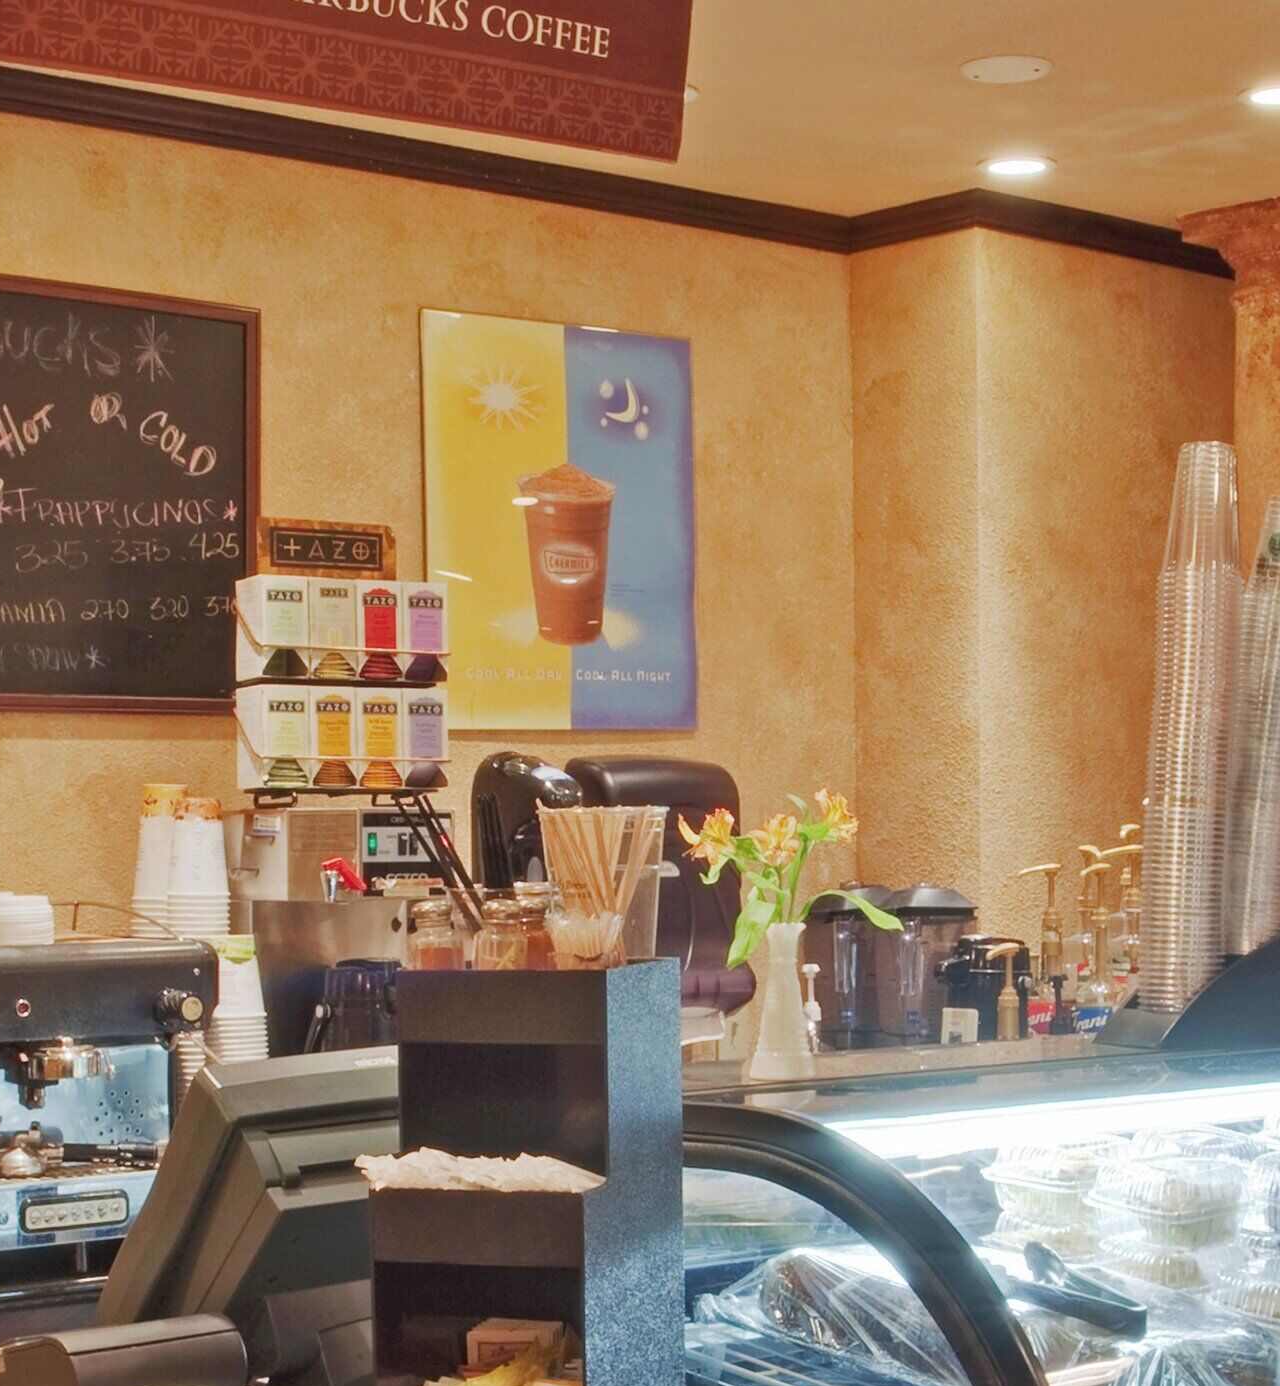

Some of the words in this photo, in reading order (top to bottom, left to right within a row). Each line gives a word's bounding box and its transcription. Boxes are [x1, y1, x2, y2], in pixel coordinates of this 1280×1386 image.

[481, 5, 610, 58] COFFEE
[90, 392, 128, 431] OR
[139, 410, 218, 476] COLD
[269, 590, 301, 601] TAZO
[365, 595, 396, 606] TAZO
[411, 598, 441, 608] TAZO
[271, 702, 303, 711] TAZO
[319, 702, 350, 712] TAZO
[365, 703, 396, 713] TAZO
[411, 704, 441, 714] TAZO
